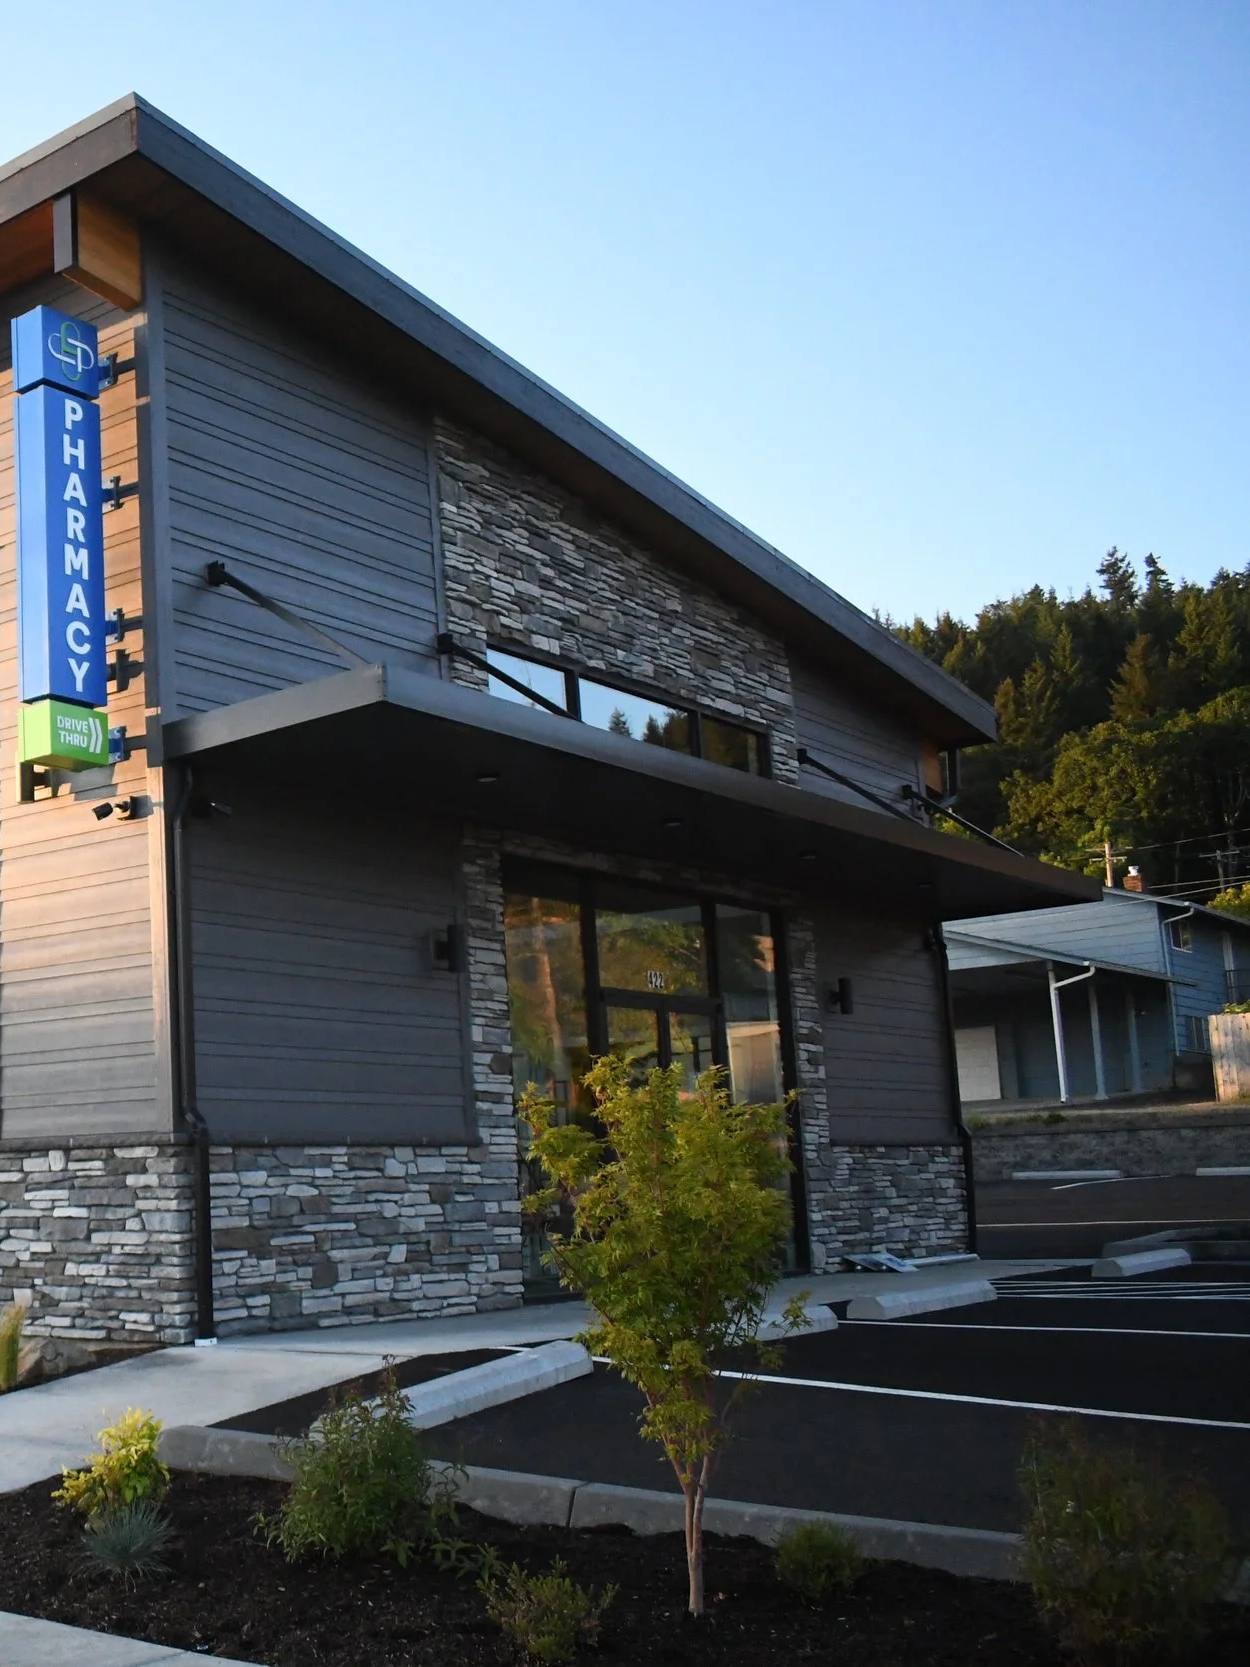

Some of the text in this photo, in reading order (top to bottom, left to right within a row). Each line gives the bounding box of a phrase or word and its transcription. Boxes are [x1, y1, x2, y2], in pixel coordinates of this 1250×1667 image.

[63, 398, 92, 693] PHARMACY
[57, 715, 89, 734] DRIVE
[58, 730, 88, 748] THRU
